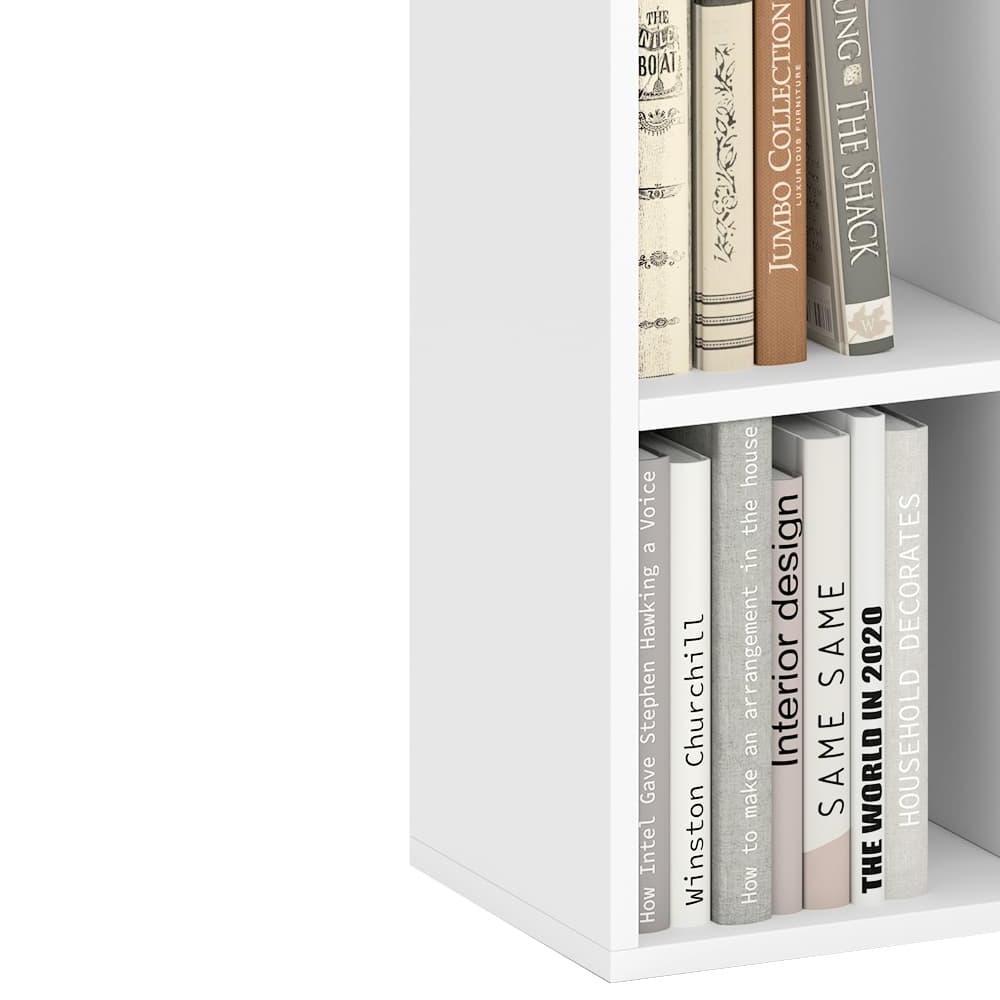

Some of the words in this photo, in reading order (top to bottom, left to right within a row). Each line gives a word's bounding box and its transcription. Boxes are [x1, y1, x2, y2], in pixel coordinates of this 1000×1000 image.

[646, 9, 669, 25] THE
[639, 50, 677, 76] BOAT
[768, 1, 792, 172] COLLECTION
[836, 90, 870, 155] THE
[768, 181, 799, 274] JUMBO
[841, 162, 880, 265] SHACK
[740, 426, 758, 488] house
[639, 471, 656, 530] Voice
[740, 499, 758, 536] the
[643, 542, 656, 553] a
[740, 549, 758, 573] in
[771, 494, 803, 622] design
[898, 493, 921, 651] DECORATES
[639, 564, 660, 650] Hawking
[817, 582, 845, 687] SAME
[744, 585, 762, 719] arrangement
[861, 606, 883, 684] 2020
[639, 661, 660, 744] Stephen
[683, 613, 704, 767] Churchill
[771, 633, 799, 767] Interior
[861, 689, 883, 721] IN
[744, 732, 758, 756] an
[817, 711, 845, 817] SAME
[898, 669, 921, 827] HOUSEHOLD
[639, 756, 656, 804] Gave
[740, 769, 758, 819] make
[861, 727, 883, 834] WORLD
[639, 816, 656, 875] Intel
[683, 785, 704, 906] Winston
[741, 830, 758, 855] to
[861, 838, 883, 894] THE
[639, 887, 656, 923] How
[741, 867, 758, 905] How
